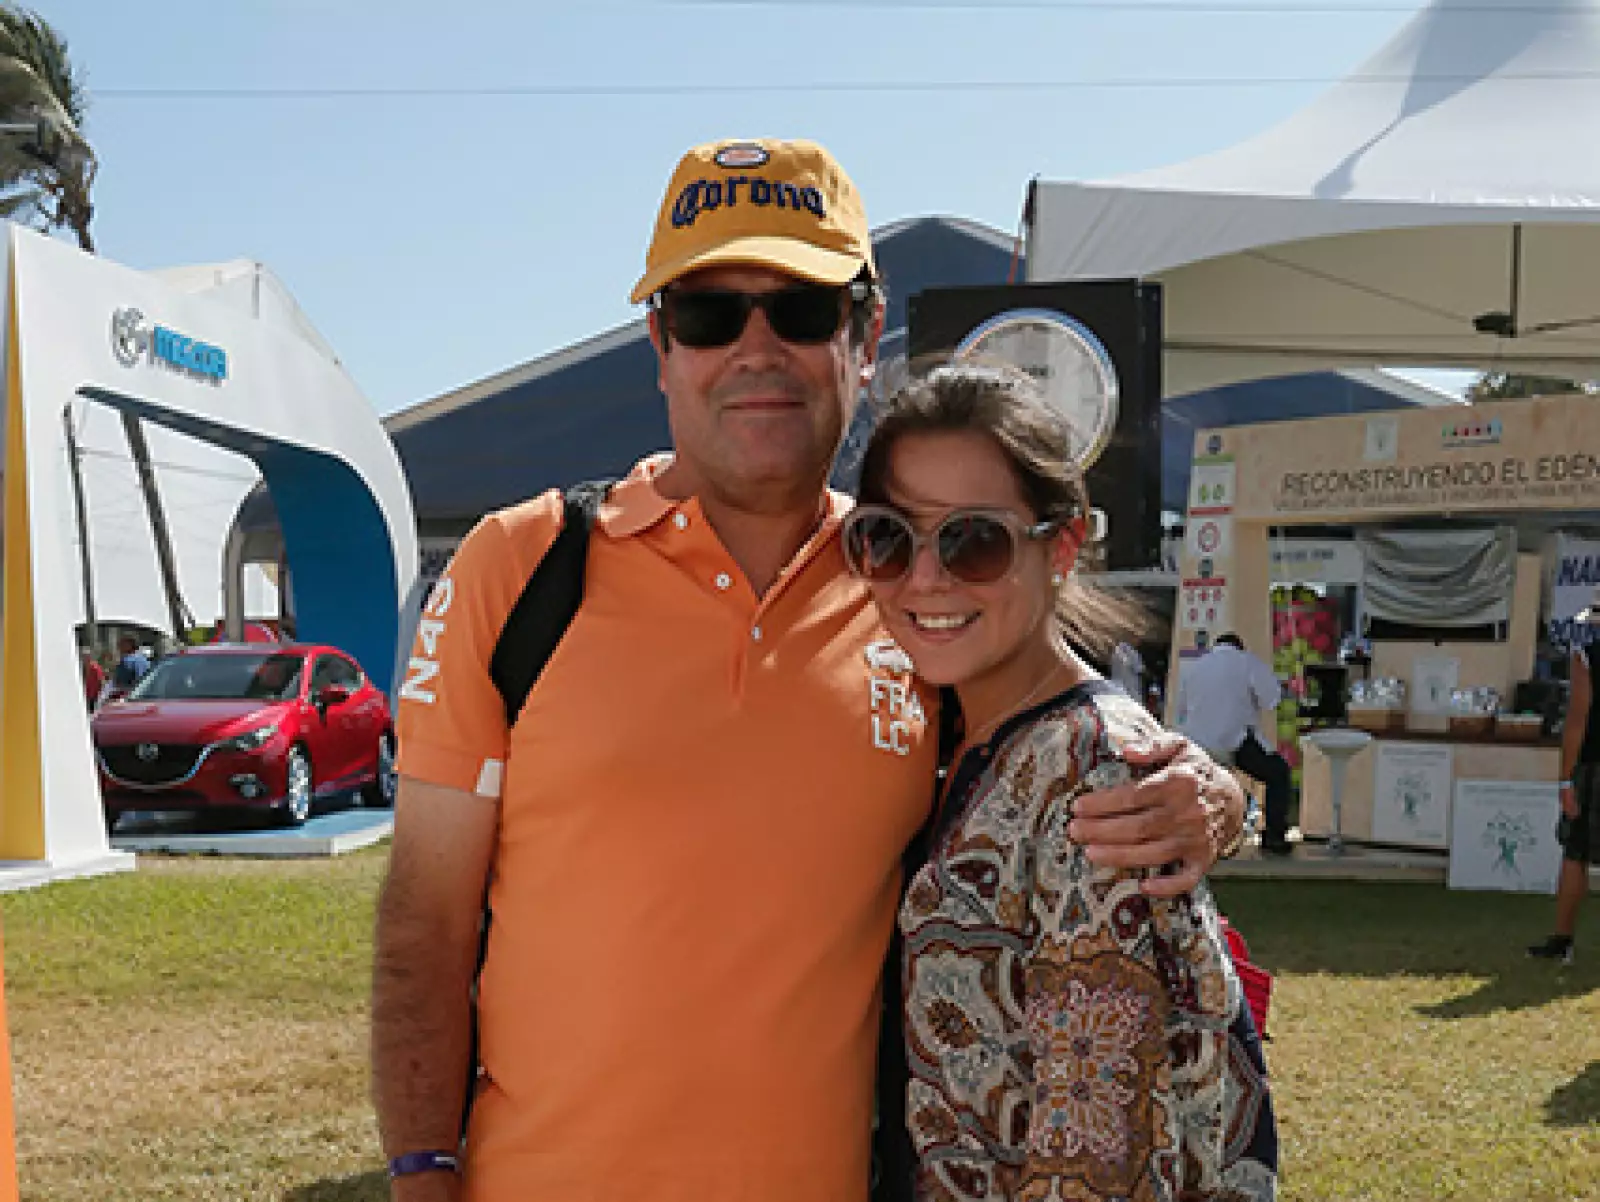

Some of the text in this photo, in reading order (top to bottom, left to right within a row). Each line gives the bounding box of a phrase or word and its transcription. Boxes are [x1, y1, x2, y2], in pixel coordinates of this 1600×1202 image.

[672, 176, 826, 229] Corona
[1281, 461, 1496, 497] RECONSTRUYENDO
[1502, 458, 1530, 484] EL
